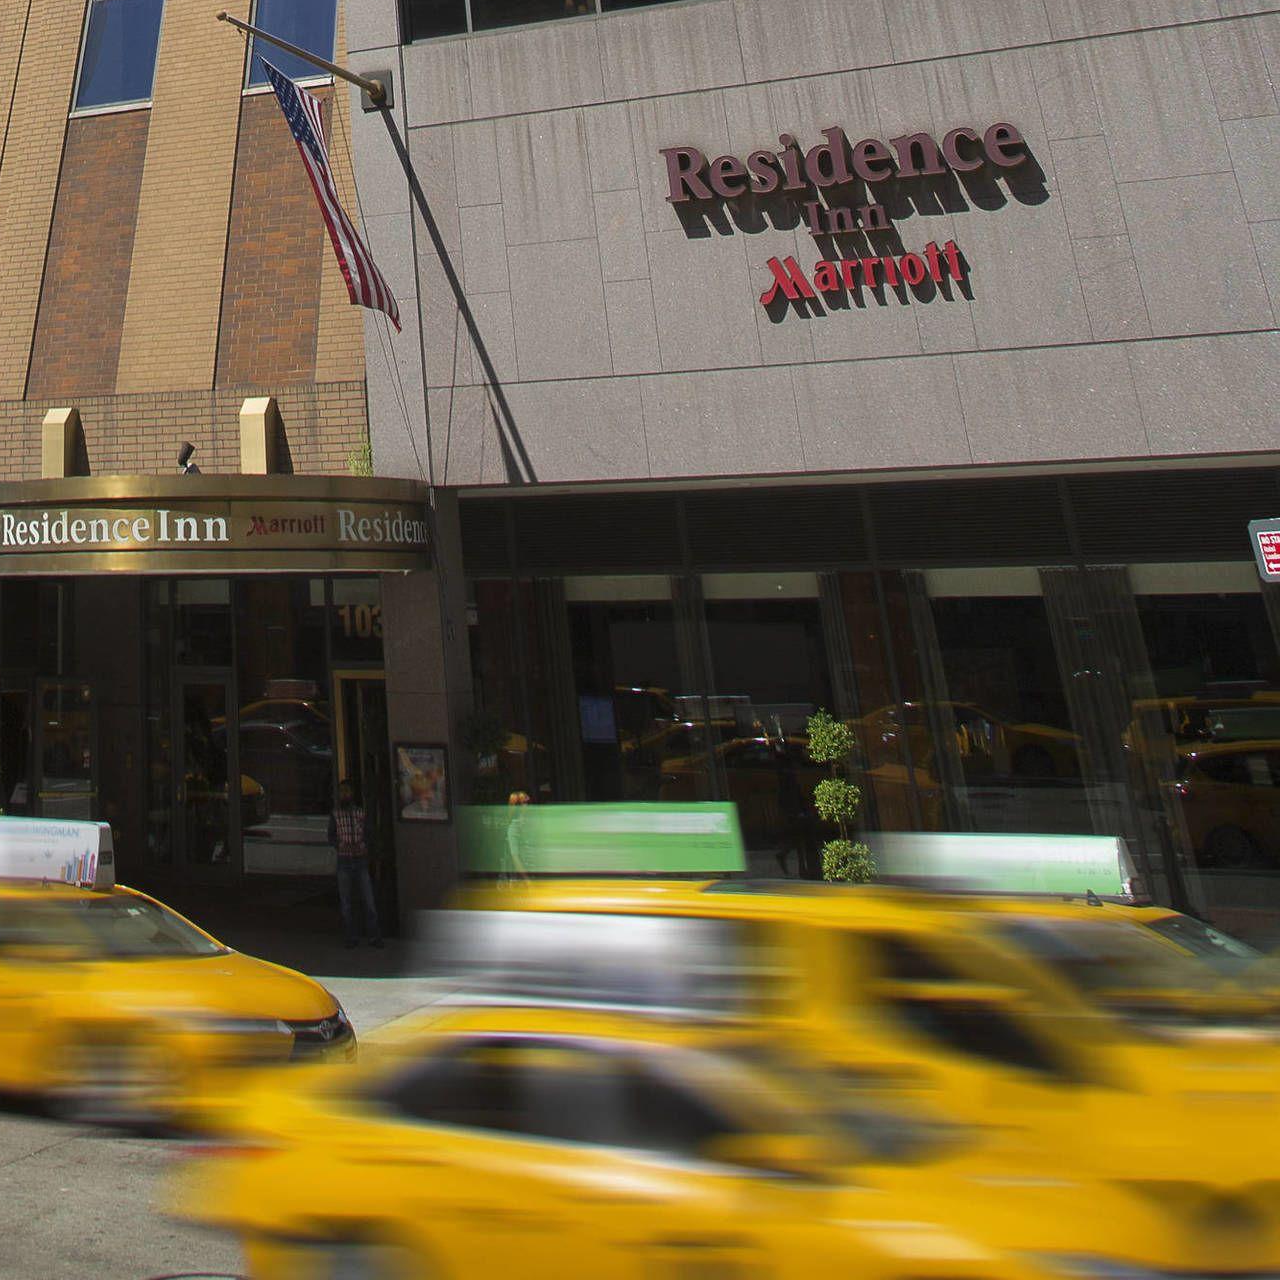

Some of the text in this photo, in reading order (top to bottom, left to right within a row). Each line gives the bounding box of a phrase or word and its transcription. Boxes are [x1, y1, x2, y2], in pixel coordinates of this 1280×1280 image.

[658, 122, 1027, 204] Residence
[804, 199, 894, 237] Inn
[759, 239, 964, 305] Marriott
[2, 510, 151, 546] Residence
[157, 509, 230, 543] Inn
[246, 514, 326, 537] Marriott
